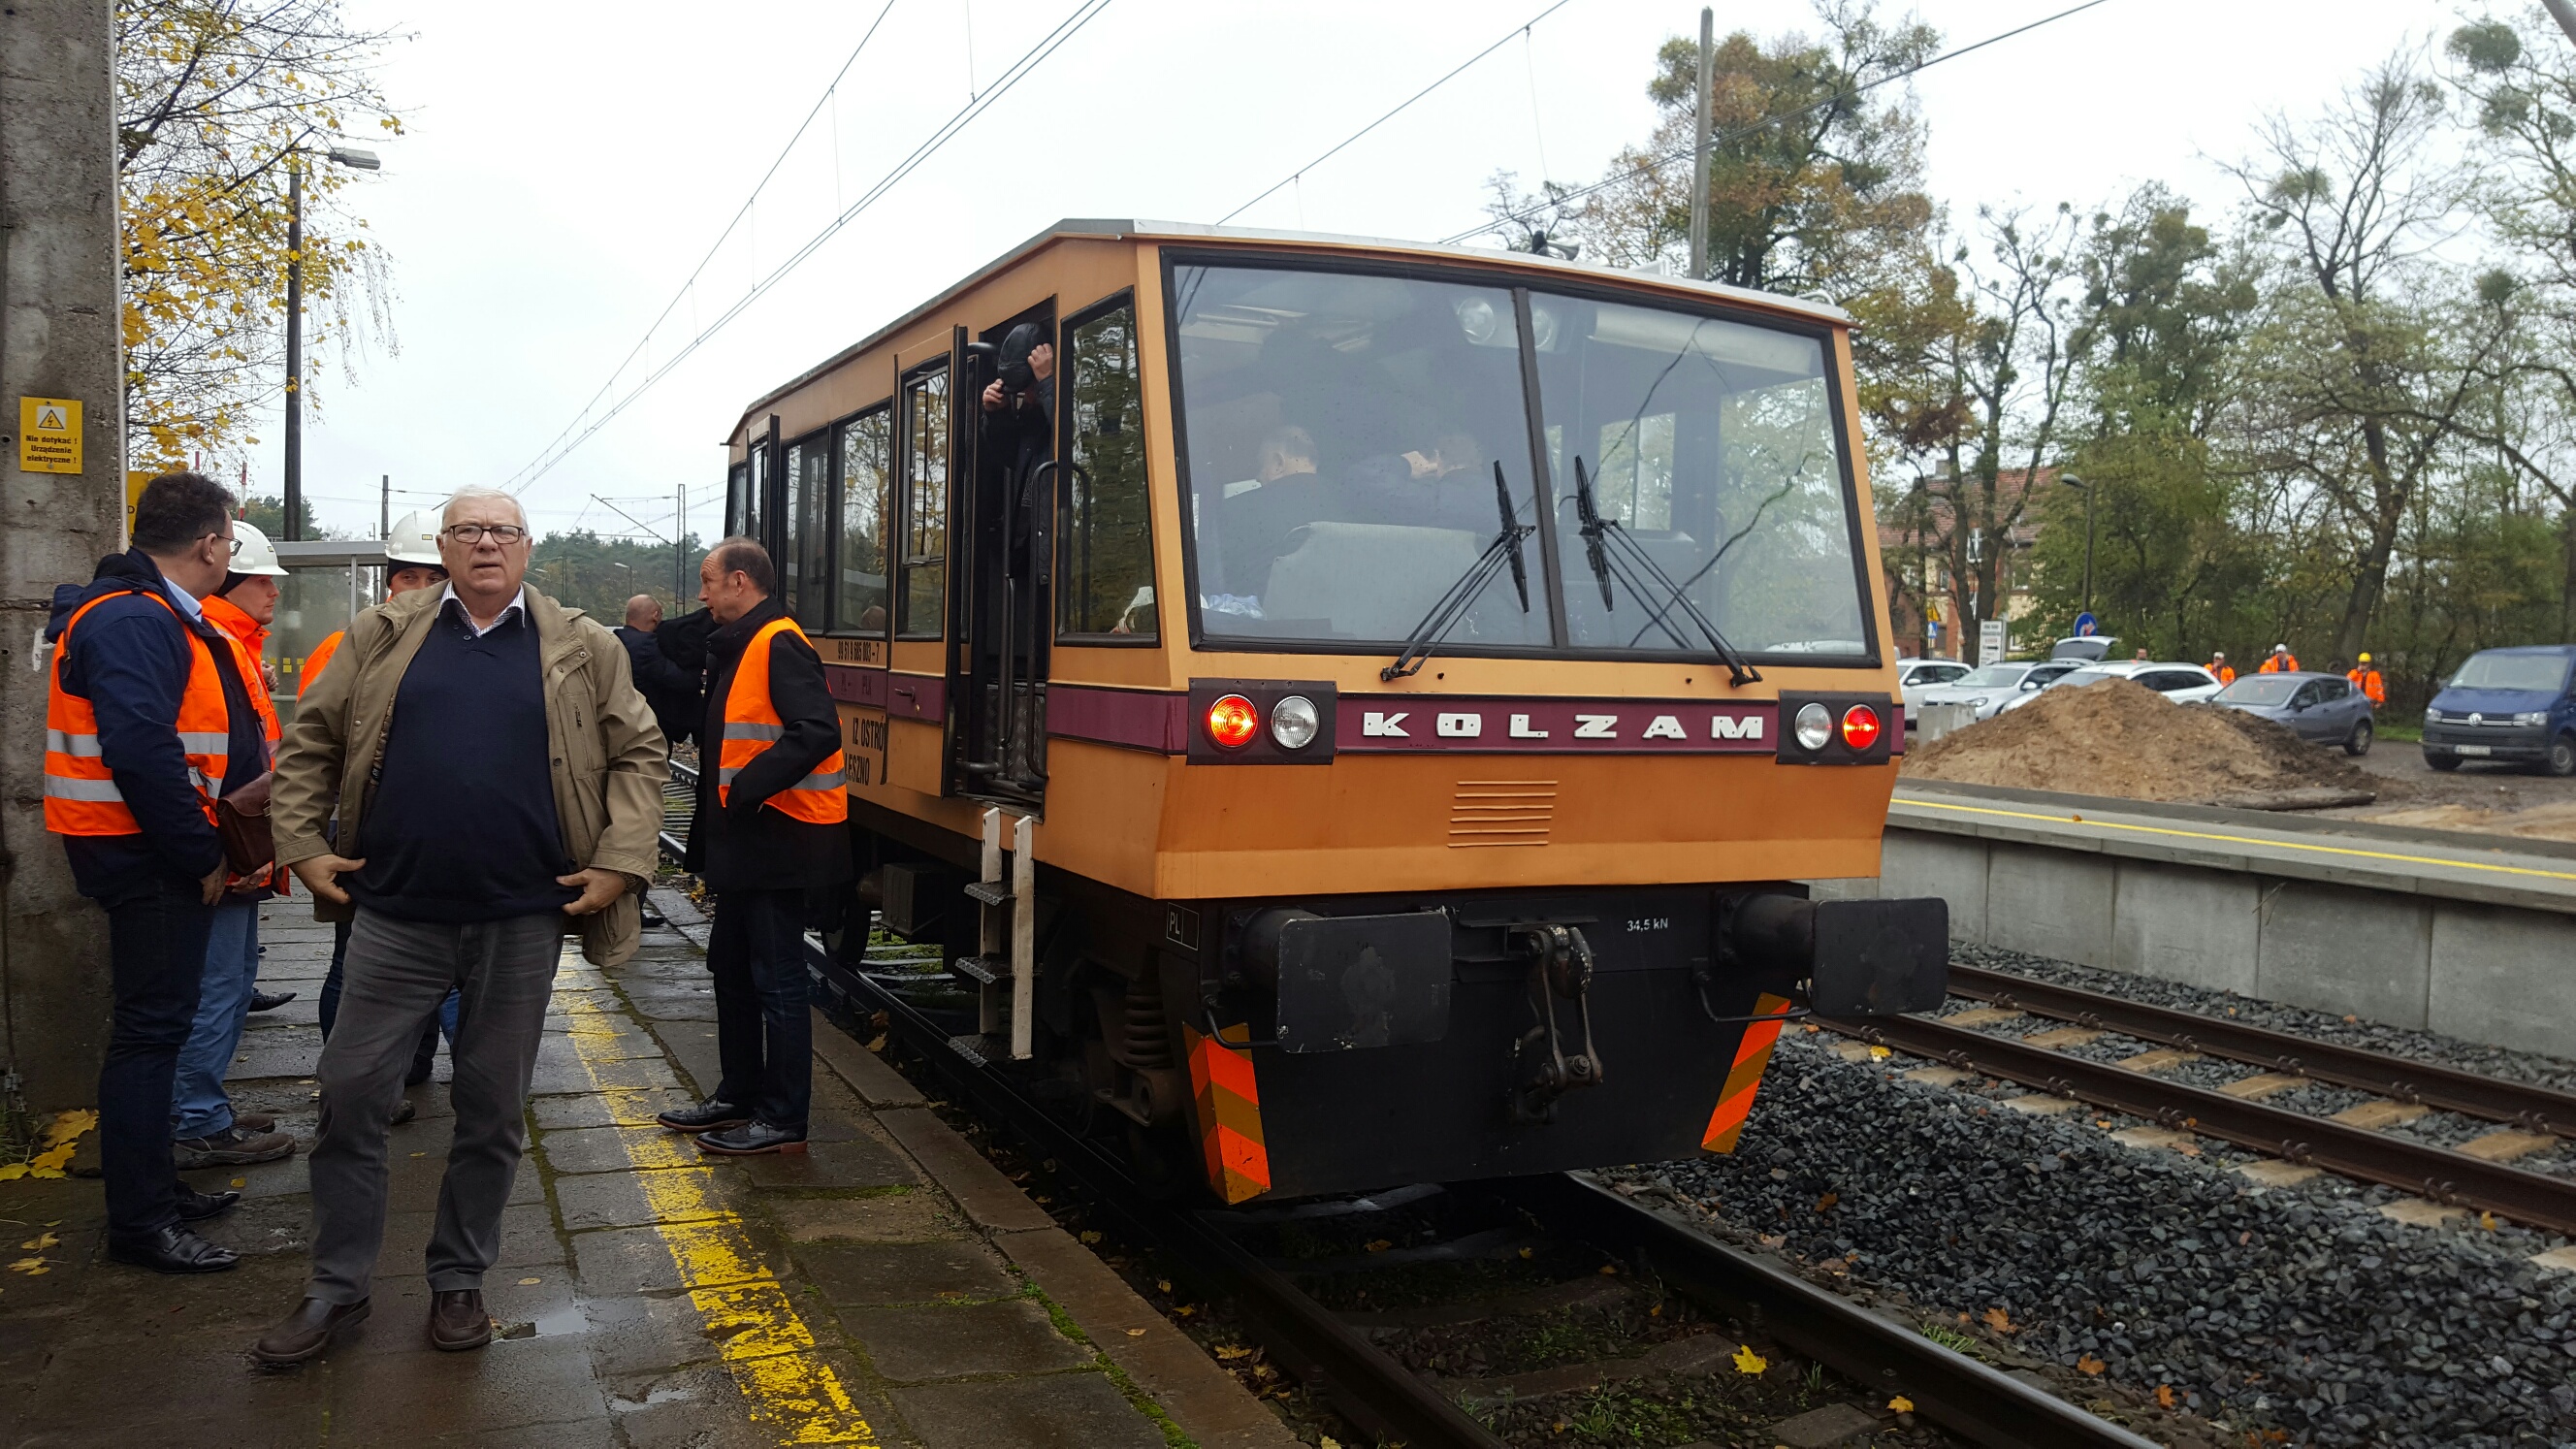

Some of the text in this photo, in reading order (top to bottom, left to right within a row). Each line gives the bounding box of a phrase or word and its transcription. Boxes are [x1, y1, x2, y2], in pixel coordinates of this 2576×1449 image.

[1362, 712, 1763, 740] KOLZAM
[1169, 911, 1180, 935] PL
[1626, 918, 1668, 933] 34,5 kN
